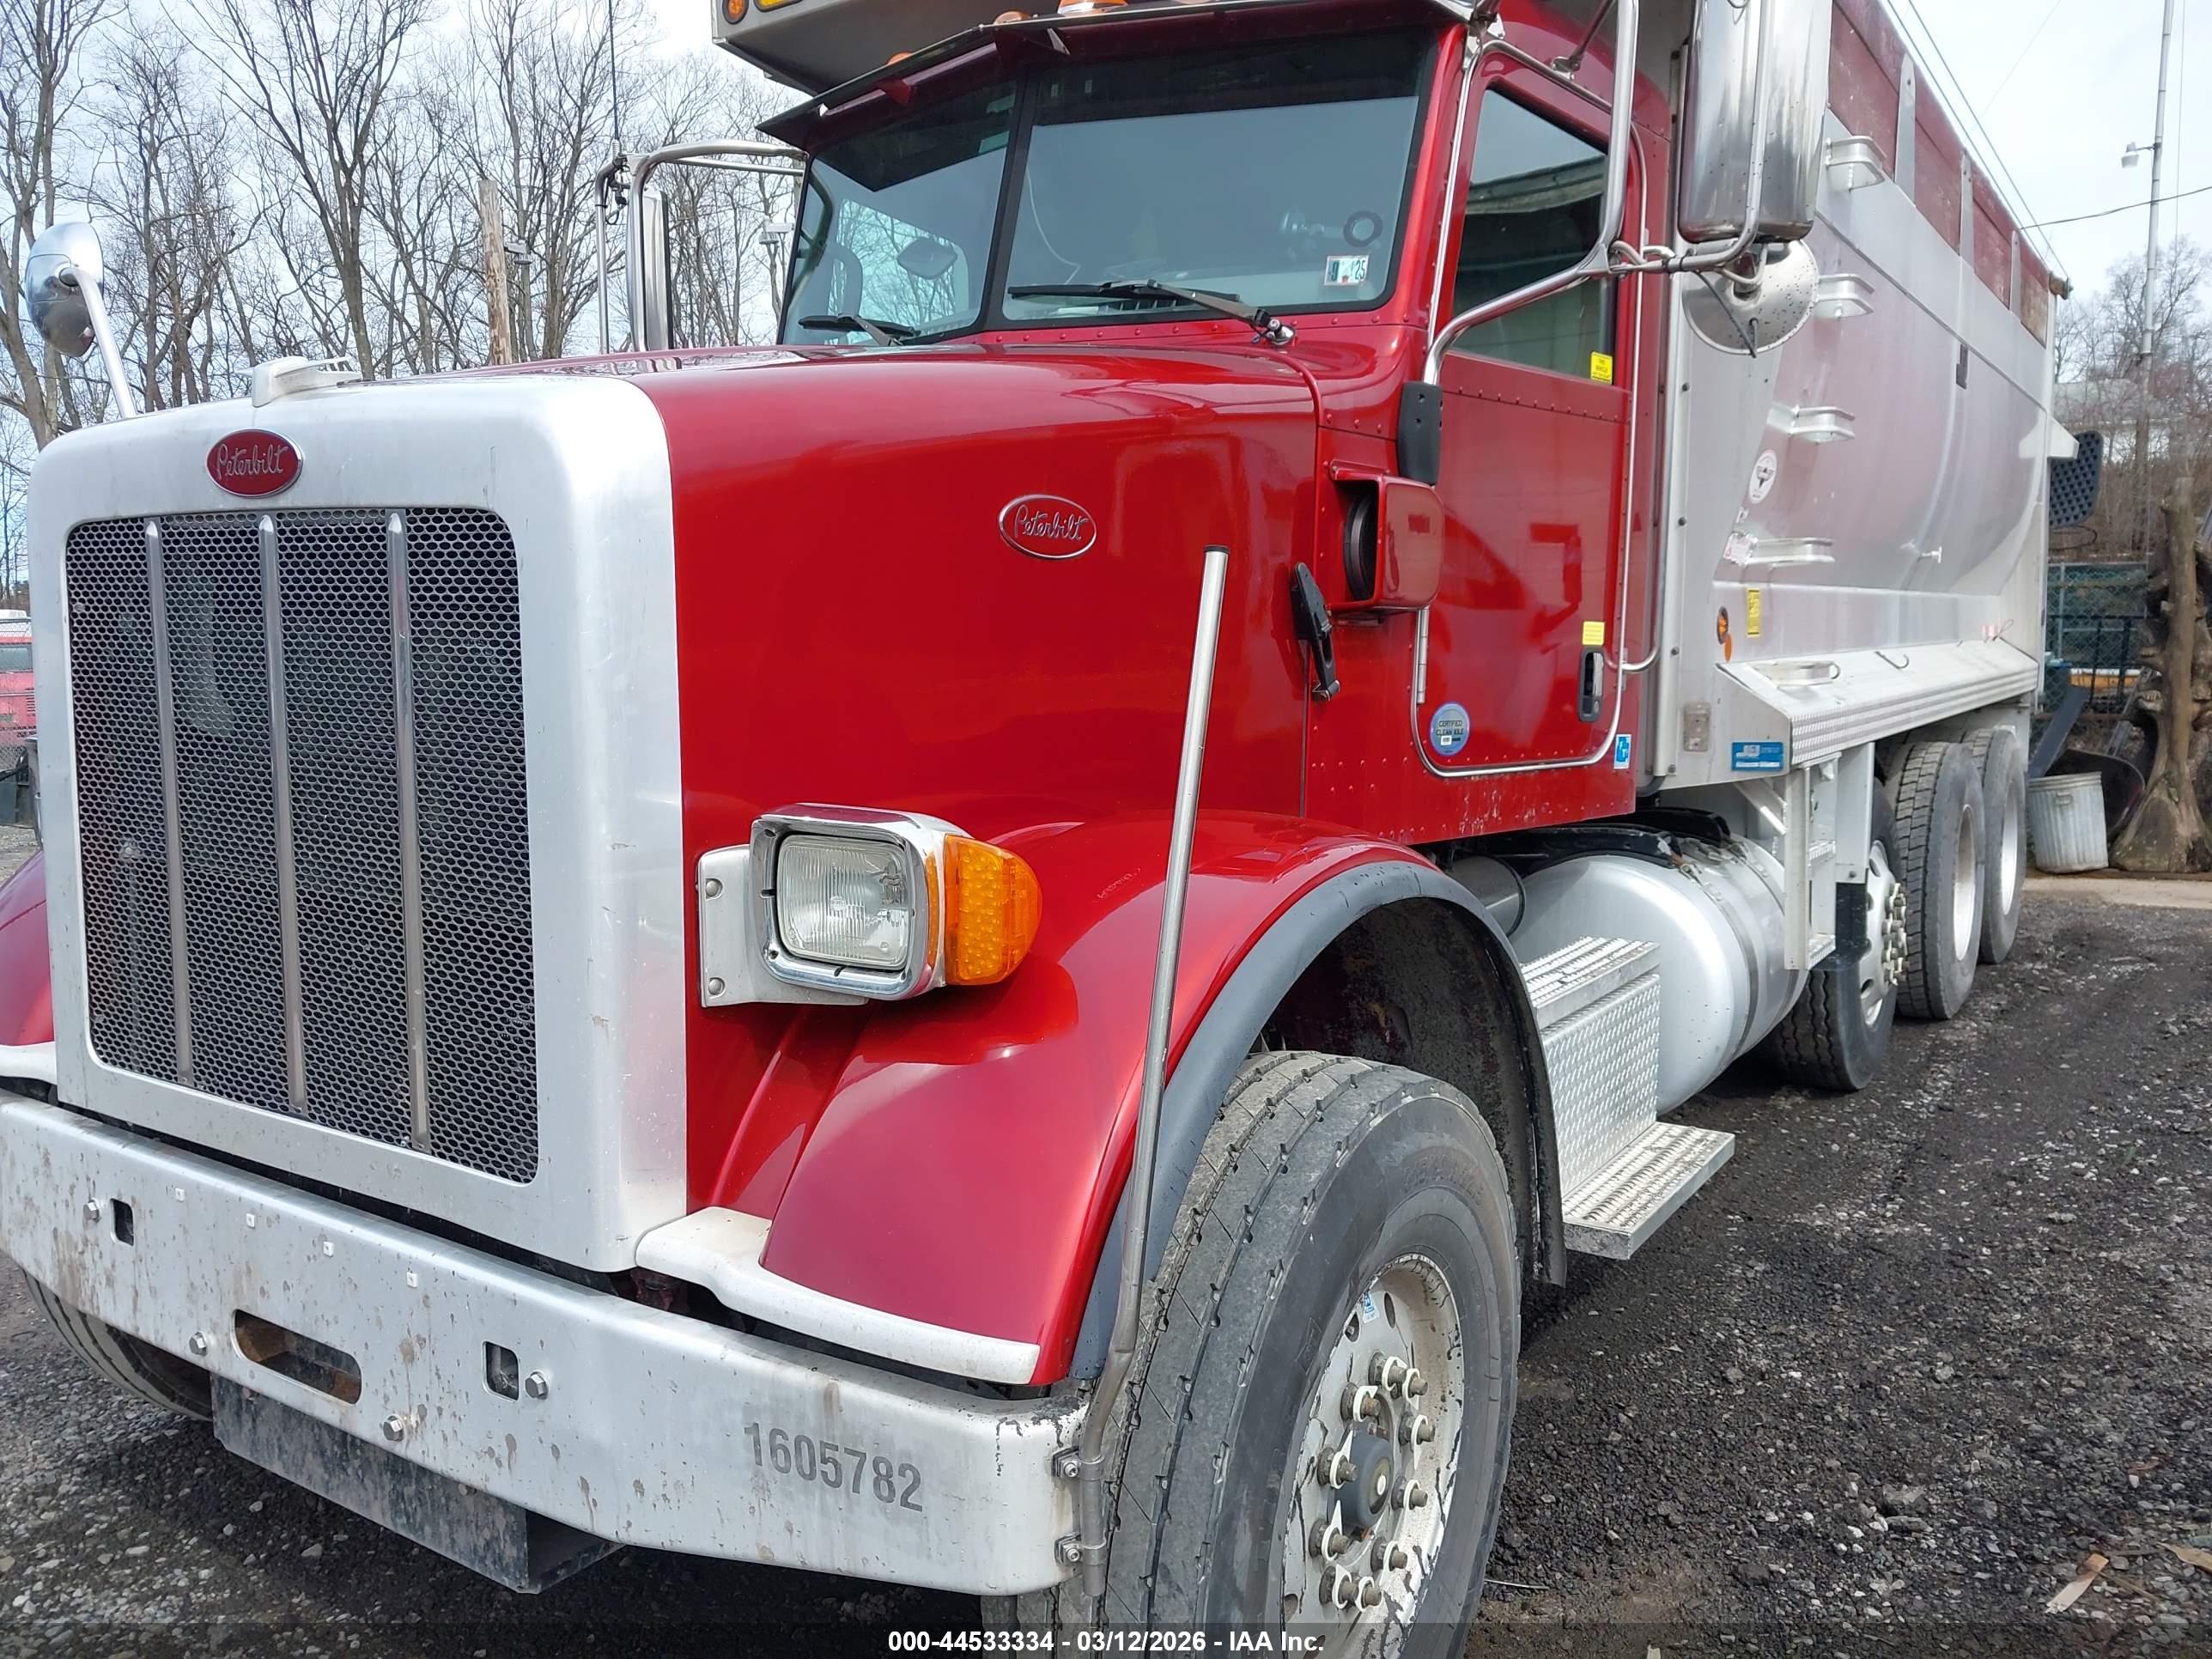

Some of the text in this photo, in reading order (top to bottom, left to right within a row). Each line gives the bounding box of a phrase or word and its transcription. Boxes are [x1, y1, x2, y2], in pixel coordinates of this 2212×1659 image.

[1354, 259, 1366, 281] 25
[216, 443, 289, 481] Peterbilt
[1014, 504, 1089, 540] Peterbilt
[744, 1422, 923, 1513] 1605782
